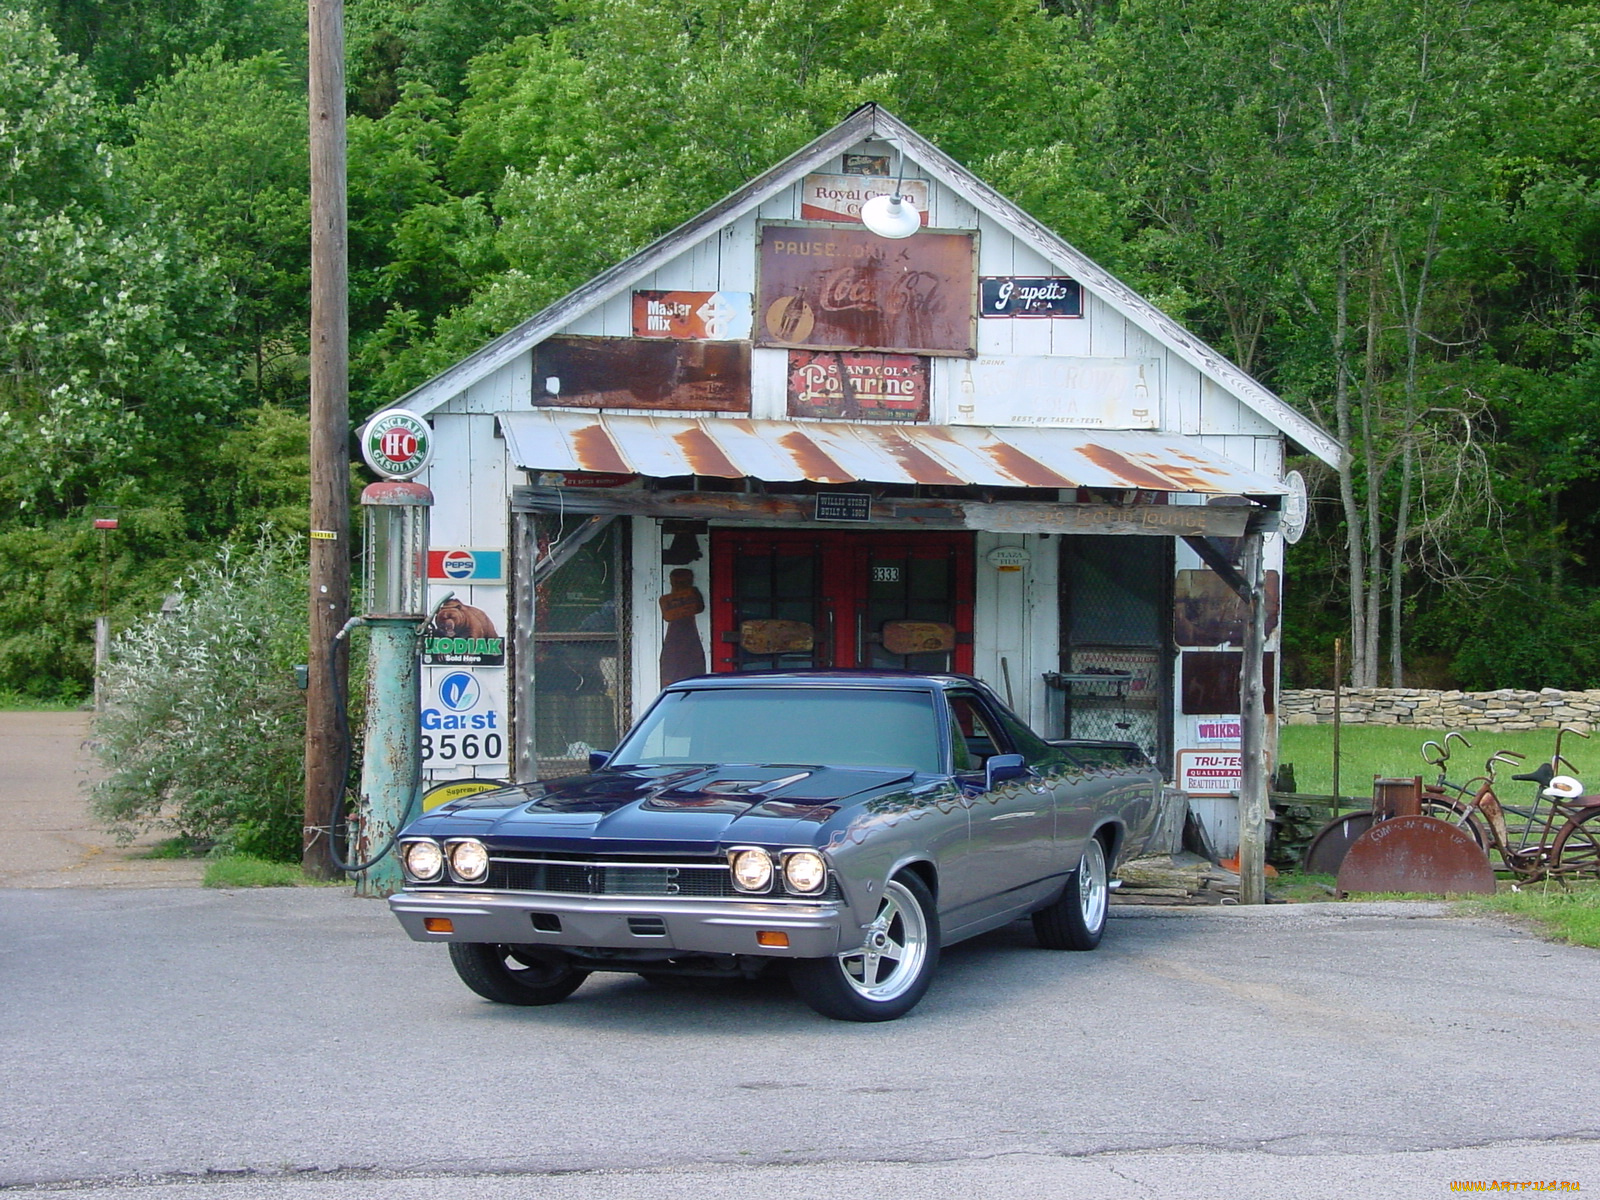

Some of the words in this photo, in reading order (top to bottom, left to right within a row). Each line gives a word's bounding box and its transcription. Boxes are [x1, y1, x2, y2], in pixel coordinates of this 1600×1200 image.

[815, 187, 860, 203] Royal
[647, 301, 692, 317] Master
[647, 316, 671, 331] Mix
[373, 418, 424, 441] SINCLAIR
[373, 449, 425, 472] GASOLINE
[445, 561, 473, 569] PEPSI
[425, 637, 503, 655] KODIAK
[421, 708, 497, 730] Garst
[1194, 757, 1242, 766] TRU-TES
[446, 786, 476, 796] Supreme
